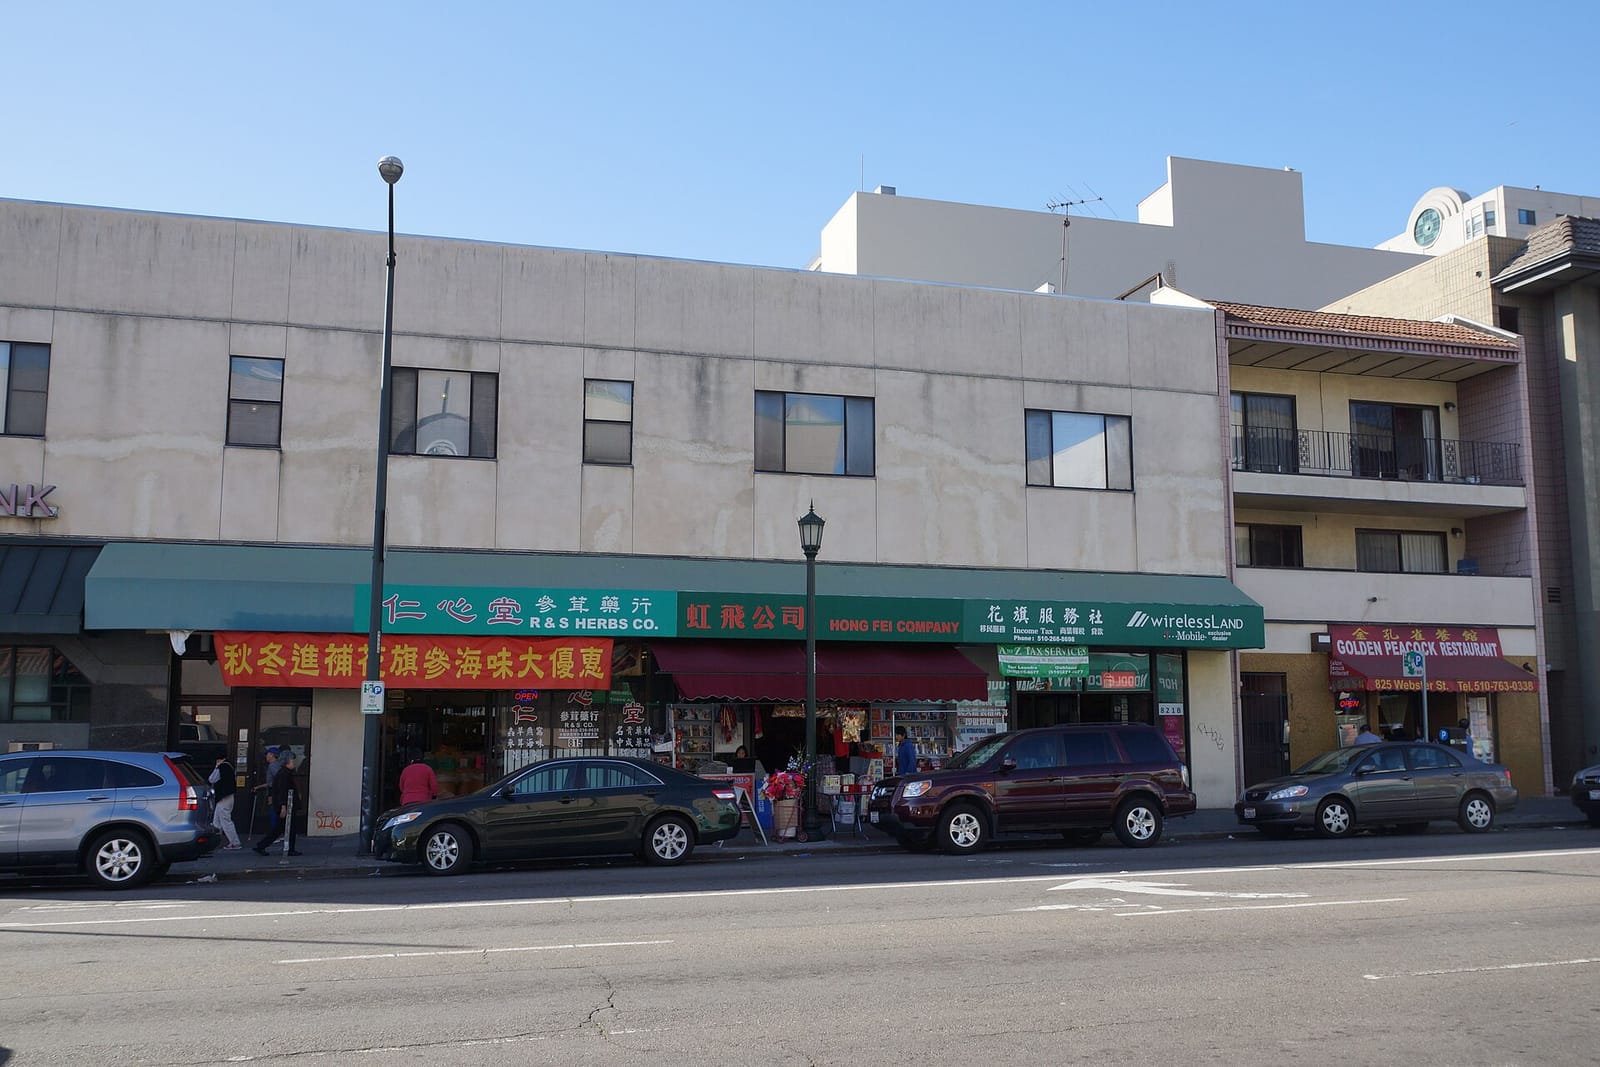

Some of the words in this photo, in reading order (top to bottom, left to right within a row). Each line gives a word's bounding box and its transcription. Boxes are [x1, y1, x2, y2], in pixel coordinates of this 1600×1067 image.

[382, 593, 523, 626] 仁心堂
[987, 605, 1104, 625] 花旗服務社
[530, 617, 540, 628] R
[544, 617, 556, 628] &
[559, 617, 569, 629] S
[575, 618, 628, 630] HERBS
[633, 618, 659, 631] CO.
[686, 603, 805, 631] 虹飛公司
[830, 619, 869, 632] HONG
[872, 620, 893, 633] FEI
[897, 620, 960, 634] COMPANY
[1013, 626, 1039, 635] Income
[1040, 627, 1054, 635] Tax
[1025, 647, 1043, 656] TAX
[1044, 647, 1087, 656] SERVICES
[1337, 639, 1381, 656] GOLDEN
[1384, 640, 1438, 656] PEACOCK
[1440, 641, 1498, 657] RESTAURANT
[1374, 679, 1392, 689] 825
[1435, 680, 1449, 690] St.
[514, 692, 538, 700] OPEN
[1339, 699, 1359, 708] OPEN
